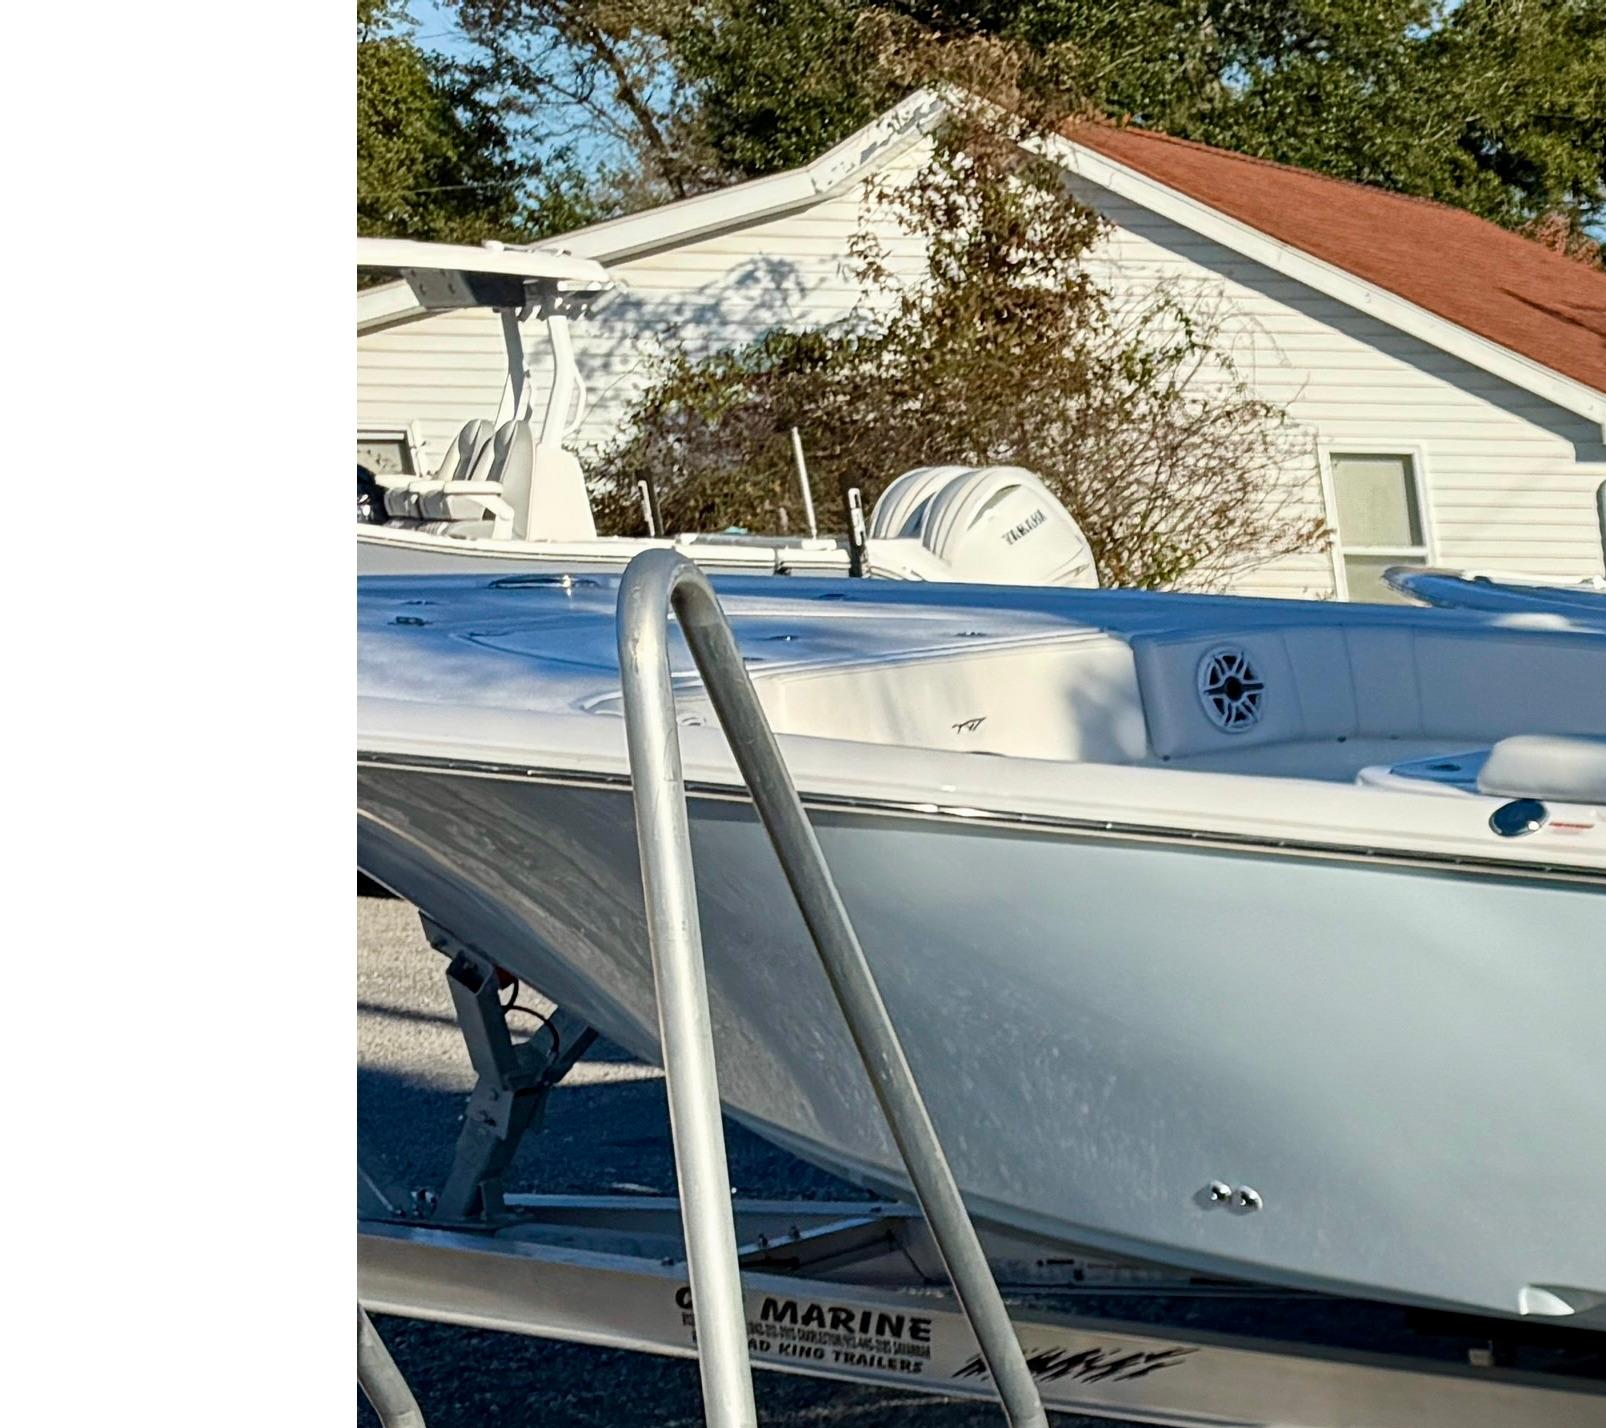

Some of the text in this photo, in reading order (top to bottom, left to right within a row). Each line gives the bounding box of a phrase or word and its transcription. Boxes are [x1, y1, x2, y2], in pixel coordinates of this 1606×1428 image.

[760, 1297, 932, 1343] MARINE
[778, 1343, 825, 1360] KING
[832, 1350, 924, 1374] TRAILERS
